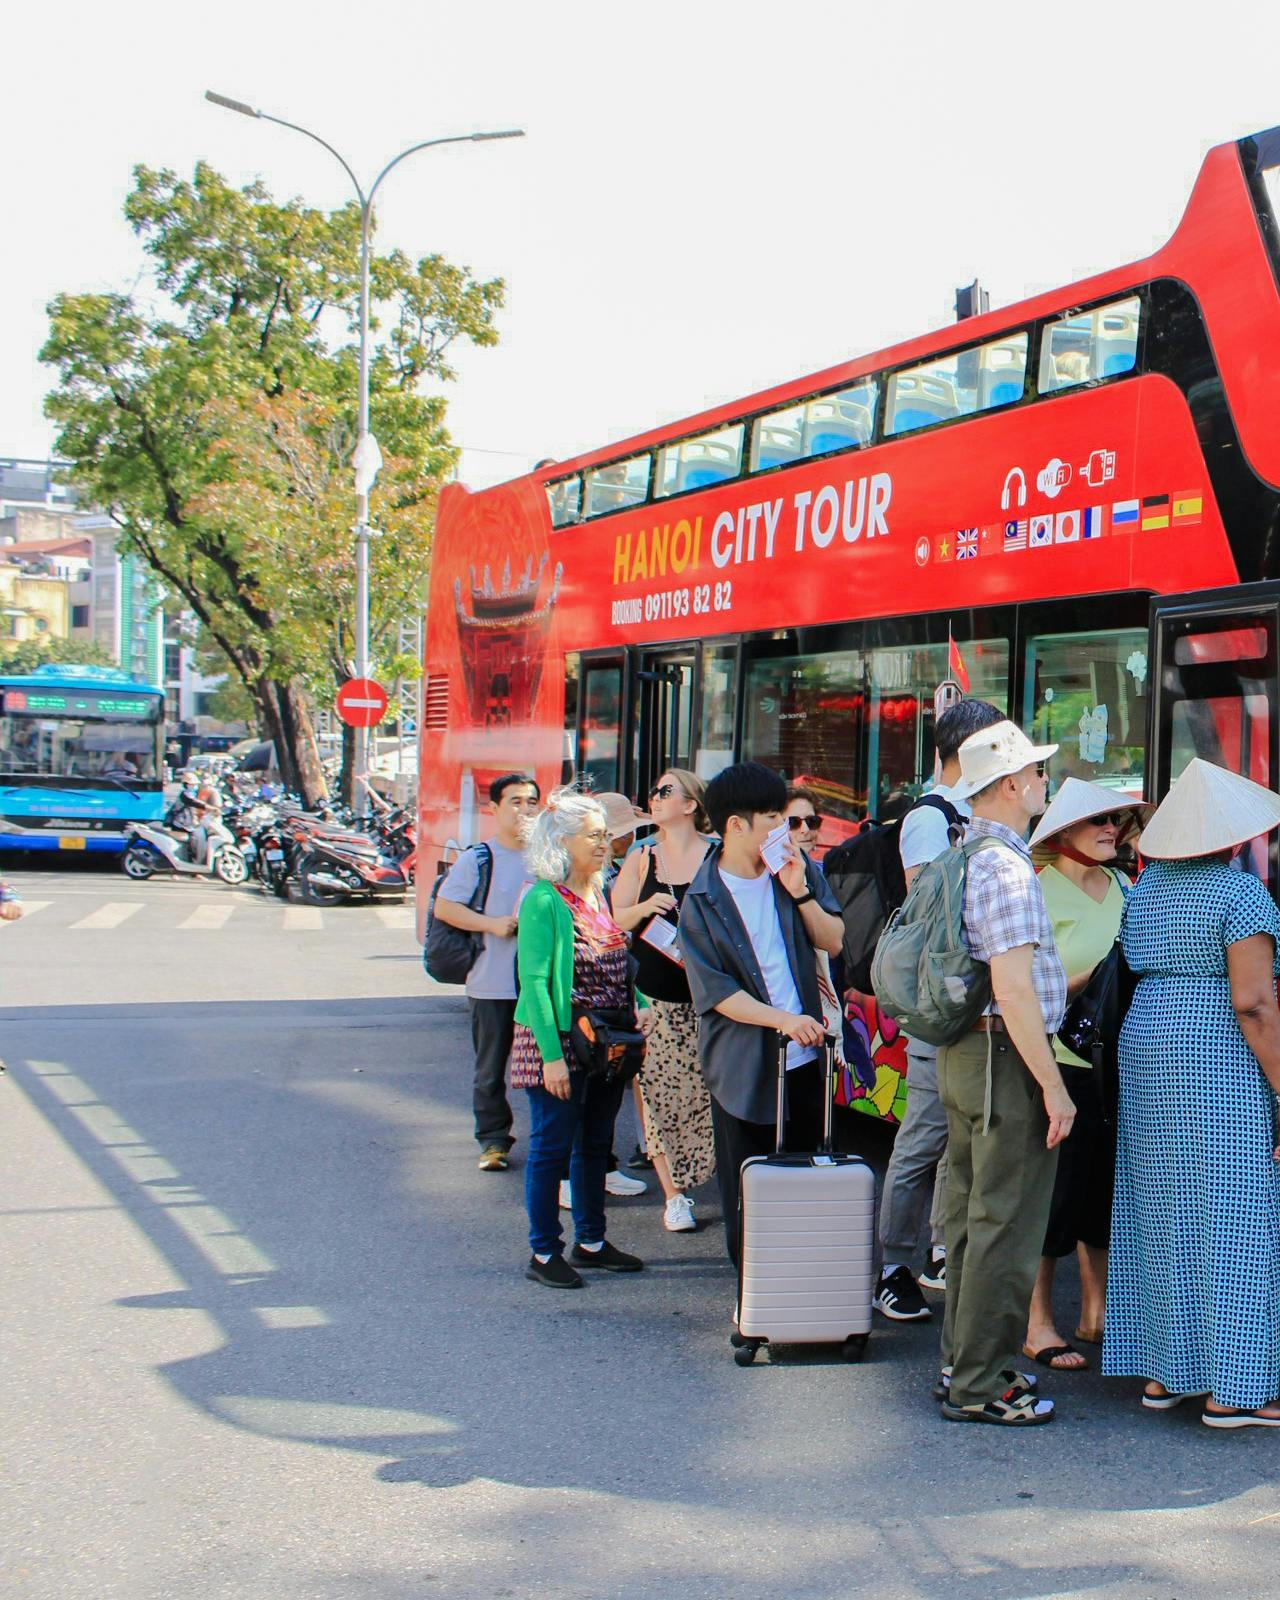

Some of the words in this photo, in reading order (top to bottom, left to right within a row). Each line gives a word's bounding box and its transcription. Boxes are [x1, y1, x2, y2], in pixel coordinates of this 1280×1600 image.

[613, 516, 703, 585] HANOI
[711, 498, 783, 568] CITY
[794, 472, 892, 552] TOUR
[611, 598, 642, 625] BOOKING
[645, 588, 690, 622] 091193
[693, 585, 710, 614] 82
[714, 581, 732, 611] 82
